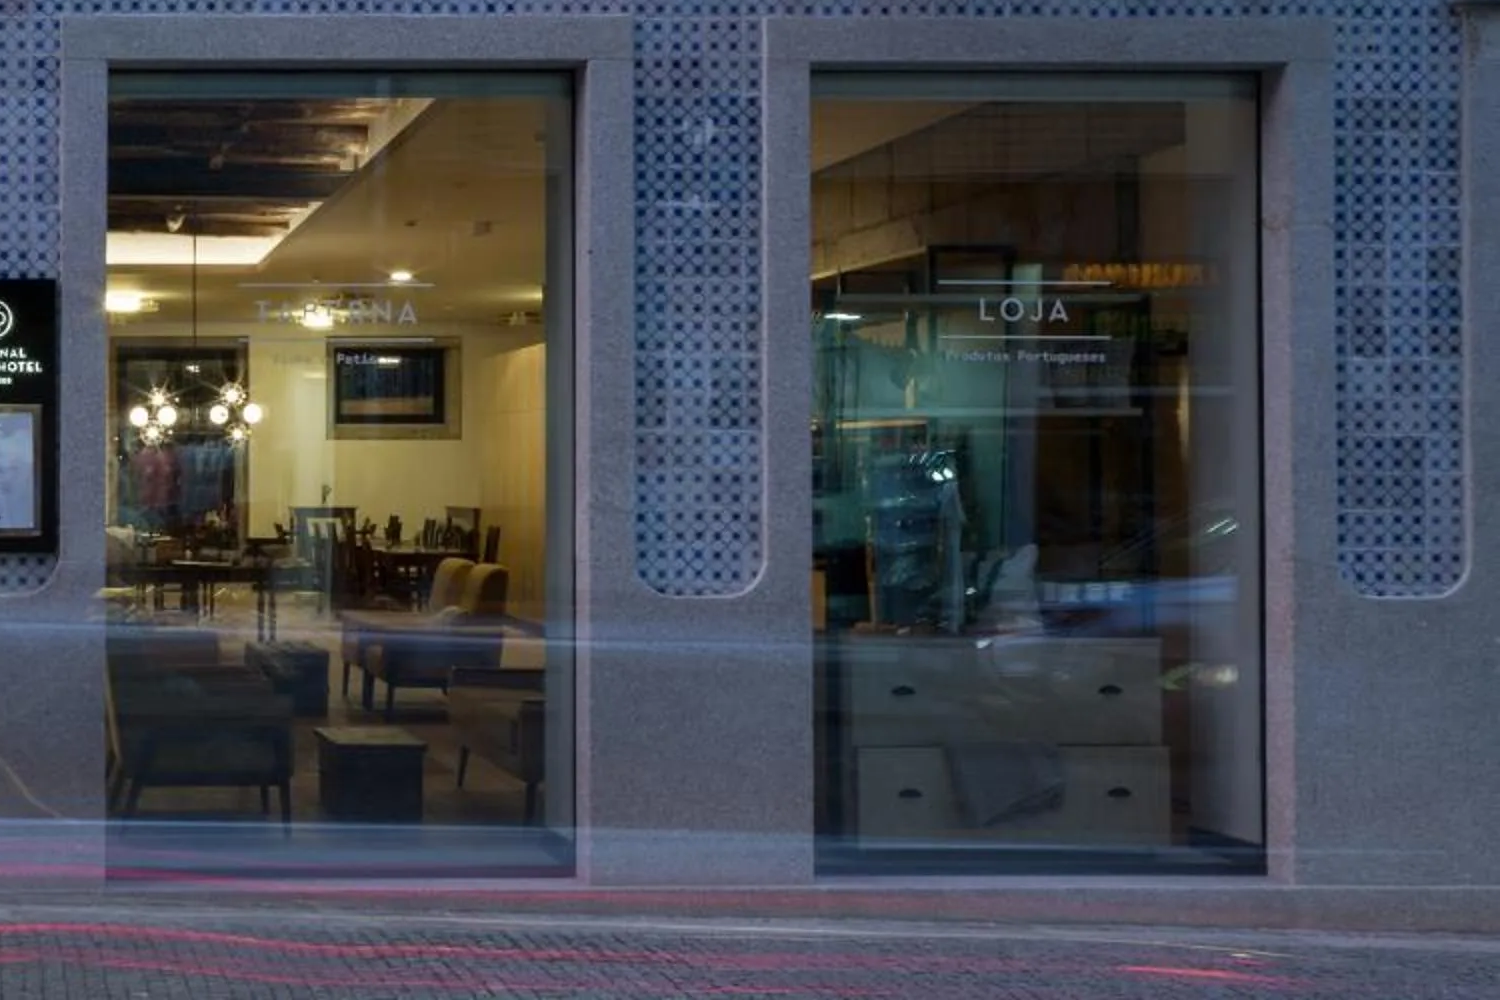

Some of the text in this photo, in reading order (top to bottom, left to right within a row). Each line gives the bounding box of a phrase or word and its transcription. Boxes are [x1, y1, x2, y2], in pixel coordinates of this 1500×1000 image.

[978, 297, 1069, 322] LOJA
[337, 352, 402, 366] Petis
[1017, 351, 1106, 365] Portugueses
